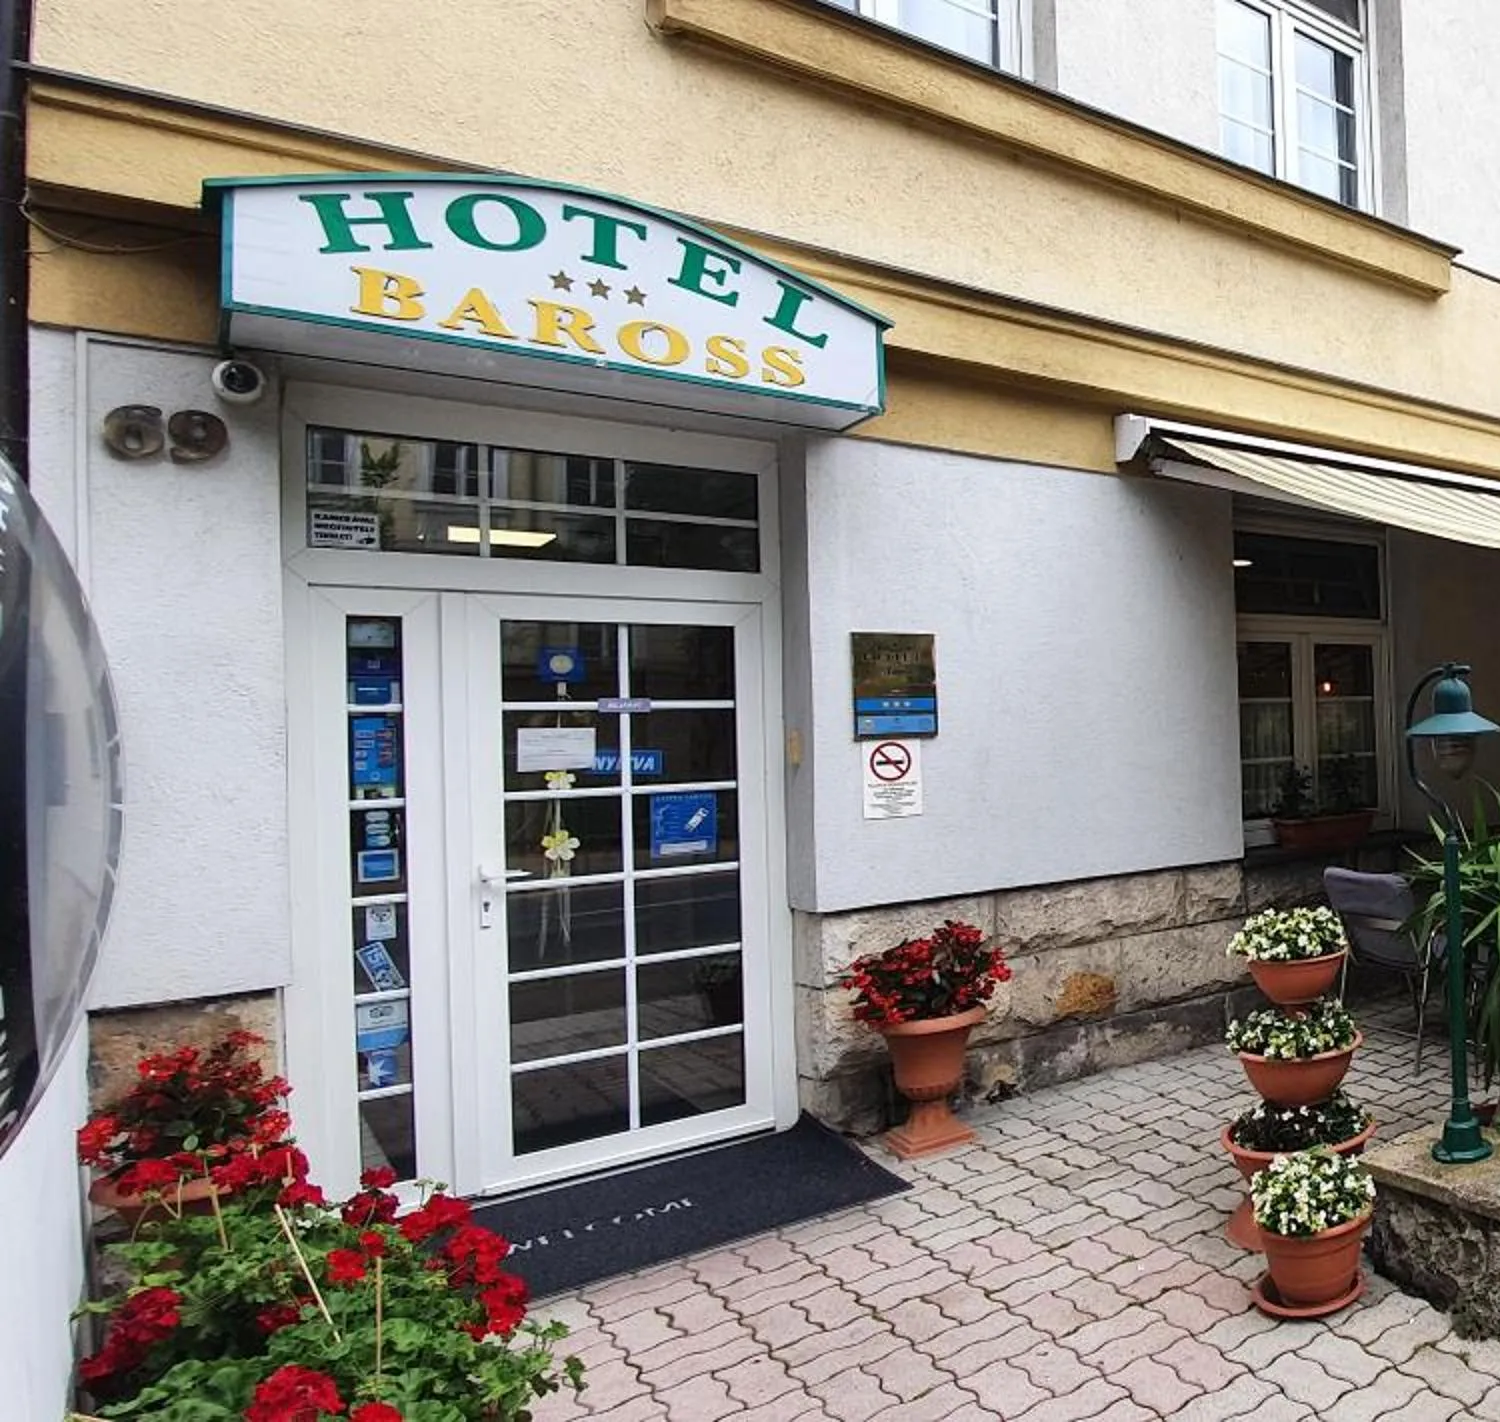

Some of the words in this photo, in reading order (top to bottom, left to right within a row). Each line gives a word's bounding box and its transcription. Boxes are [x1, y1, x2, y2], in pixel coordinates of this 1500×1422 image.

[299, 190, 830, 350] HOTEL
[349, 265, 807, 389] BAROSS
[104, 404, 229, 465] 69
[592, 755, 655, 771] NYIVA
